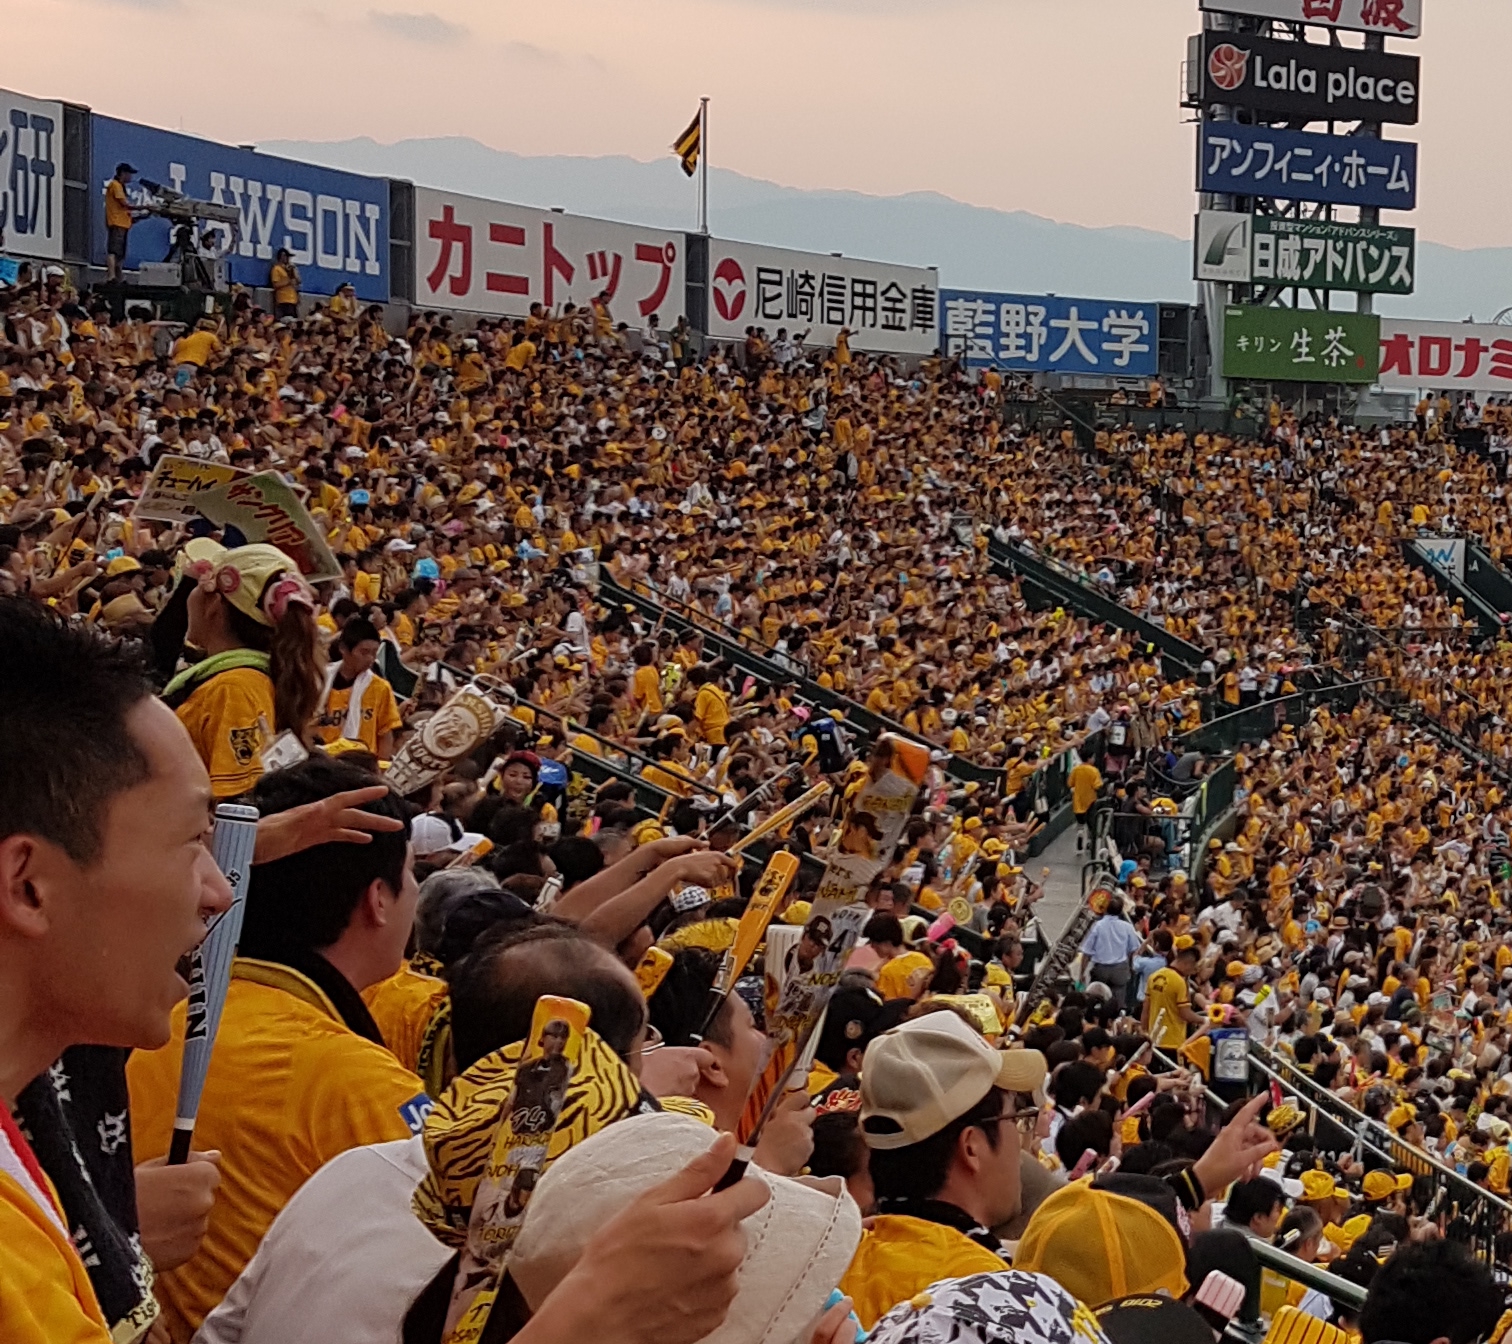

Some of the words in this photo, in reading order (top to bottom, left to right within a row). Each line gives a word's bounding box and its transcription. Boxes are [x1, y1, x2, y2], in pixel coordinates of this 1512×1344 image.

[1254, 55, 1317, 94] Lala
[1327, 67, 1416, 104] place
[0, 109, 56, 238] 研
[427, 204, 677, 316] カニトップ
[1253, 233, 1412, 287] 日成アドバンス
[753, 266, 939, 337] 尼崎信用金庫
[945, 298, 1150, 367] 藍野大学
[1236, 334, 1282, 353] キリン
[1289, 325, 1355, 368] 生茶
